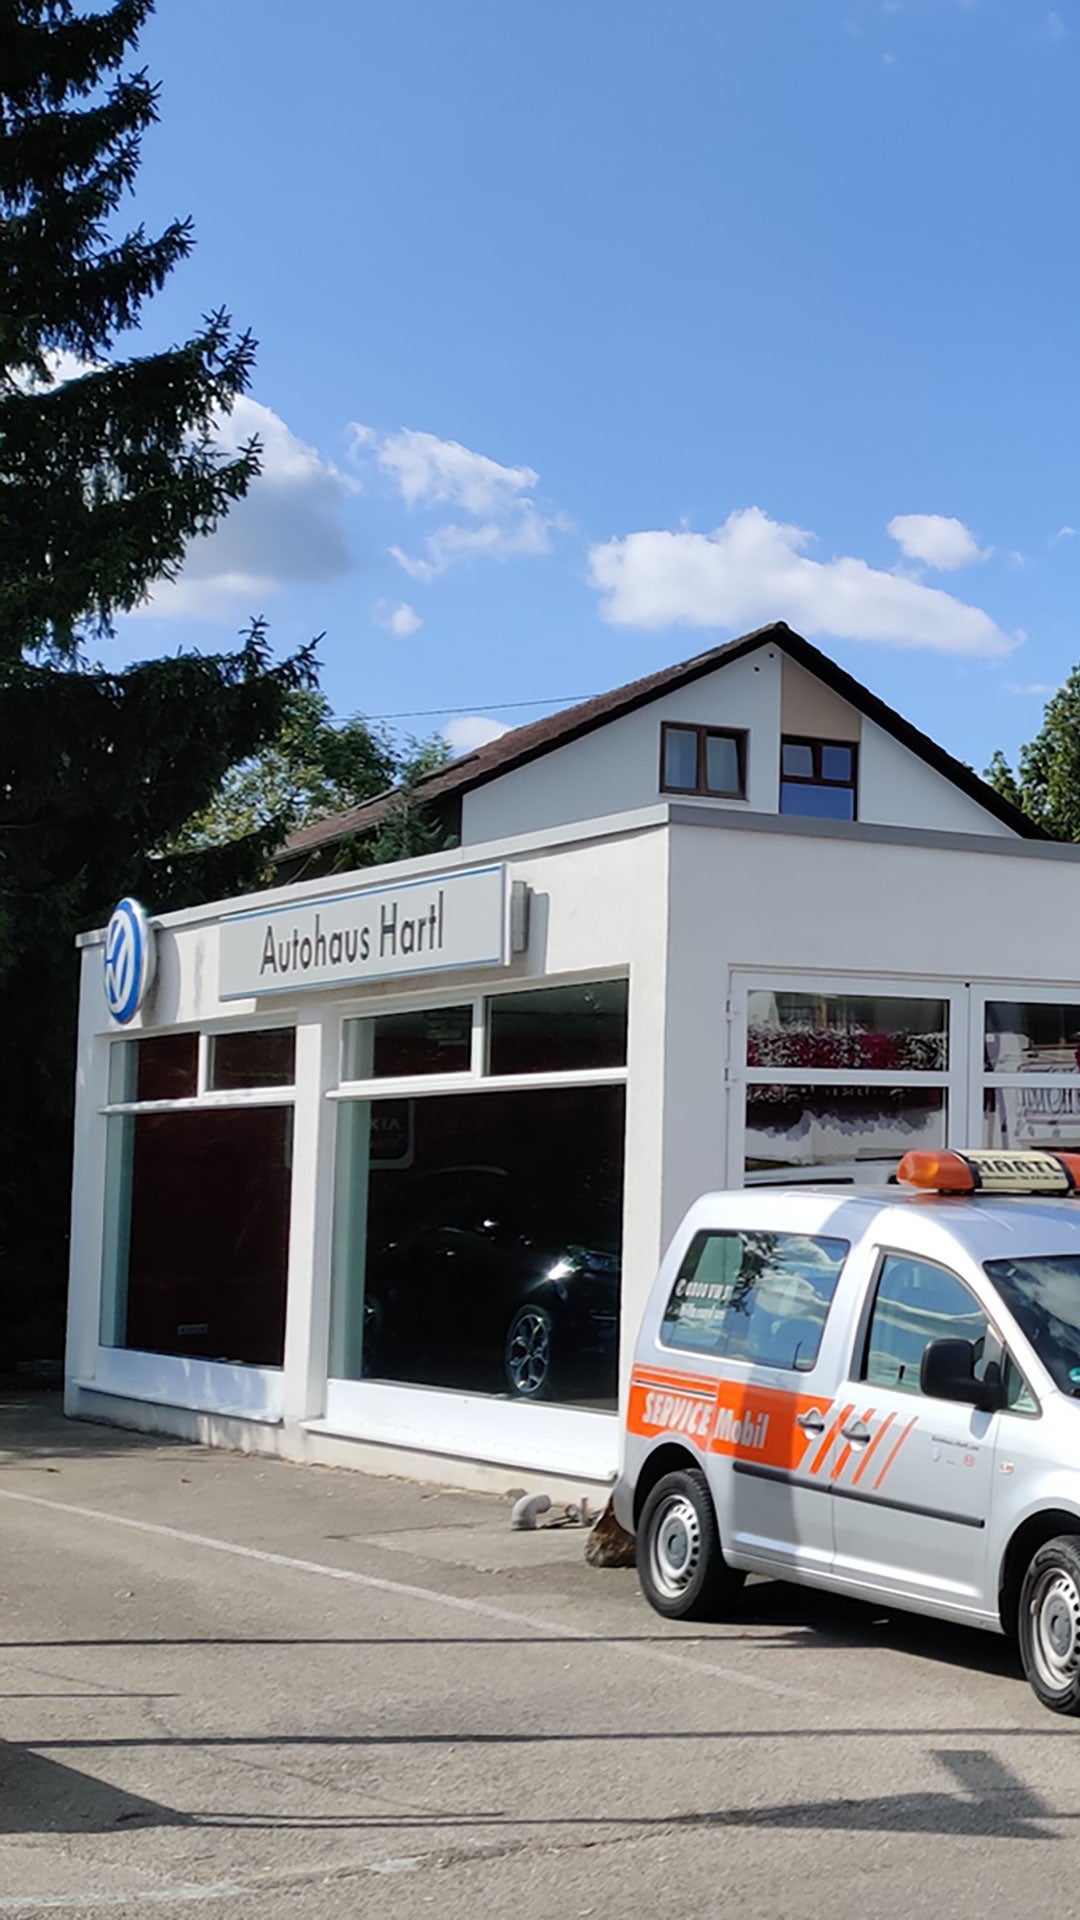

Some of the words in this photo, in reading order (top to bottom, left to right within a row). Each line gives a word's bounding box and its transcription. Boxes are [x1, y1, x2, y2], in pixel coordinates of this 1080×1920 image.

[259, 913, 371, 976] Autohaus
[379, 890, 445, 958] Hartl
[641, 1391, 714, 1437] SERVICE
[713, 1406, 771, 1450] Mobil
